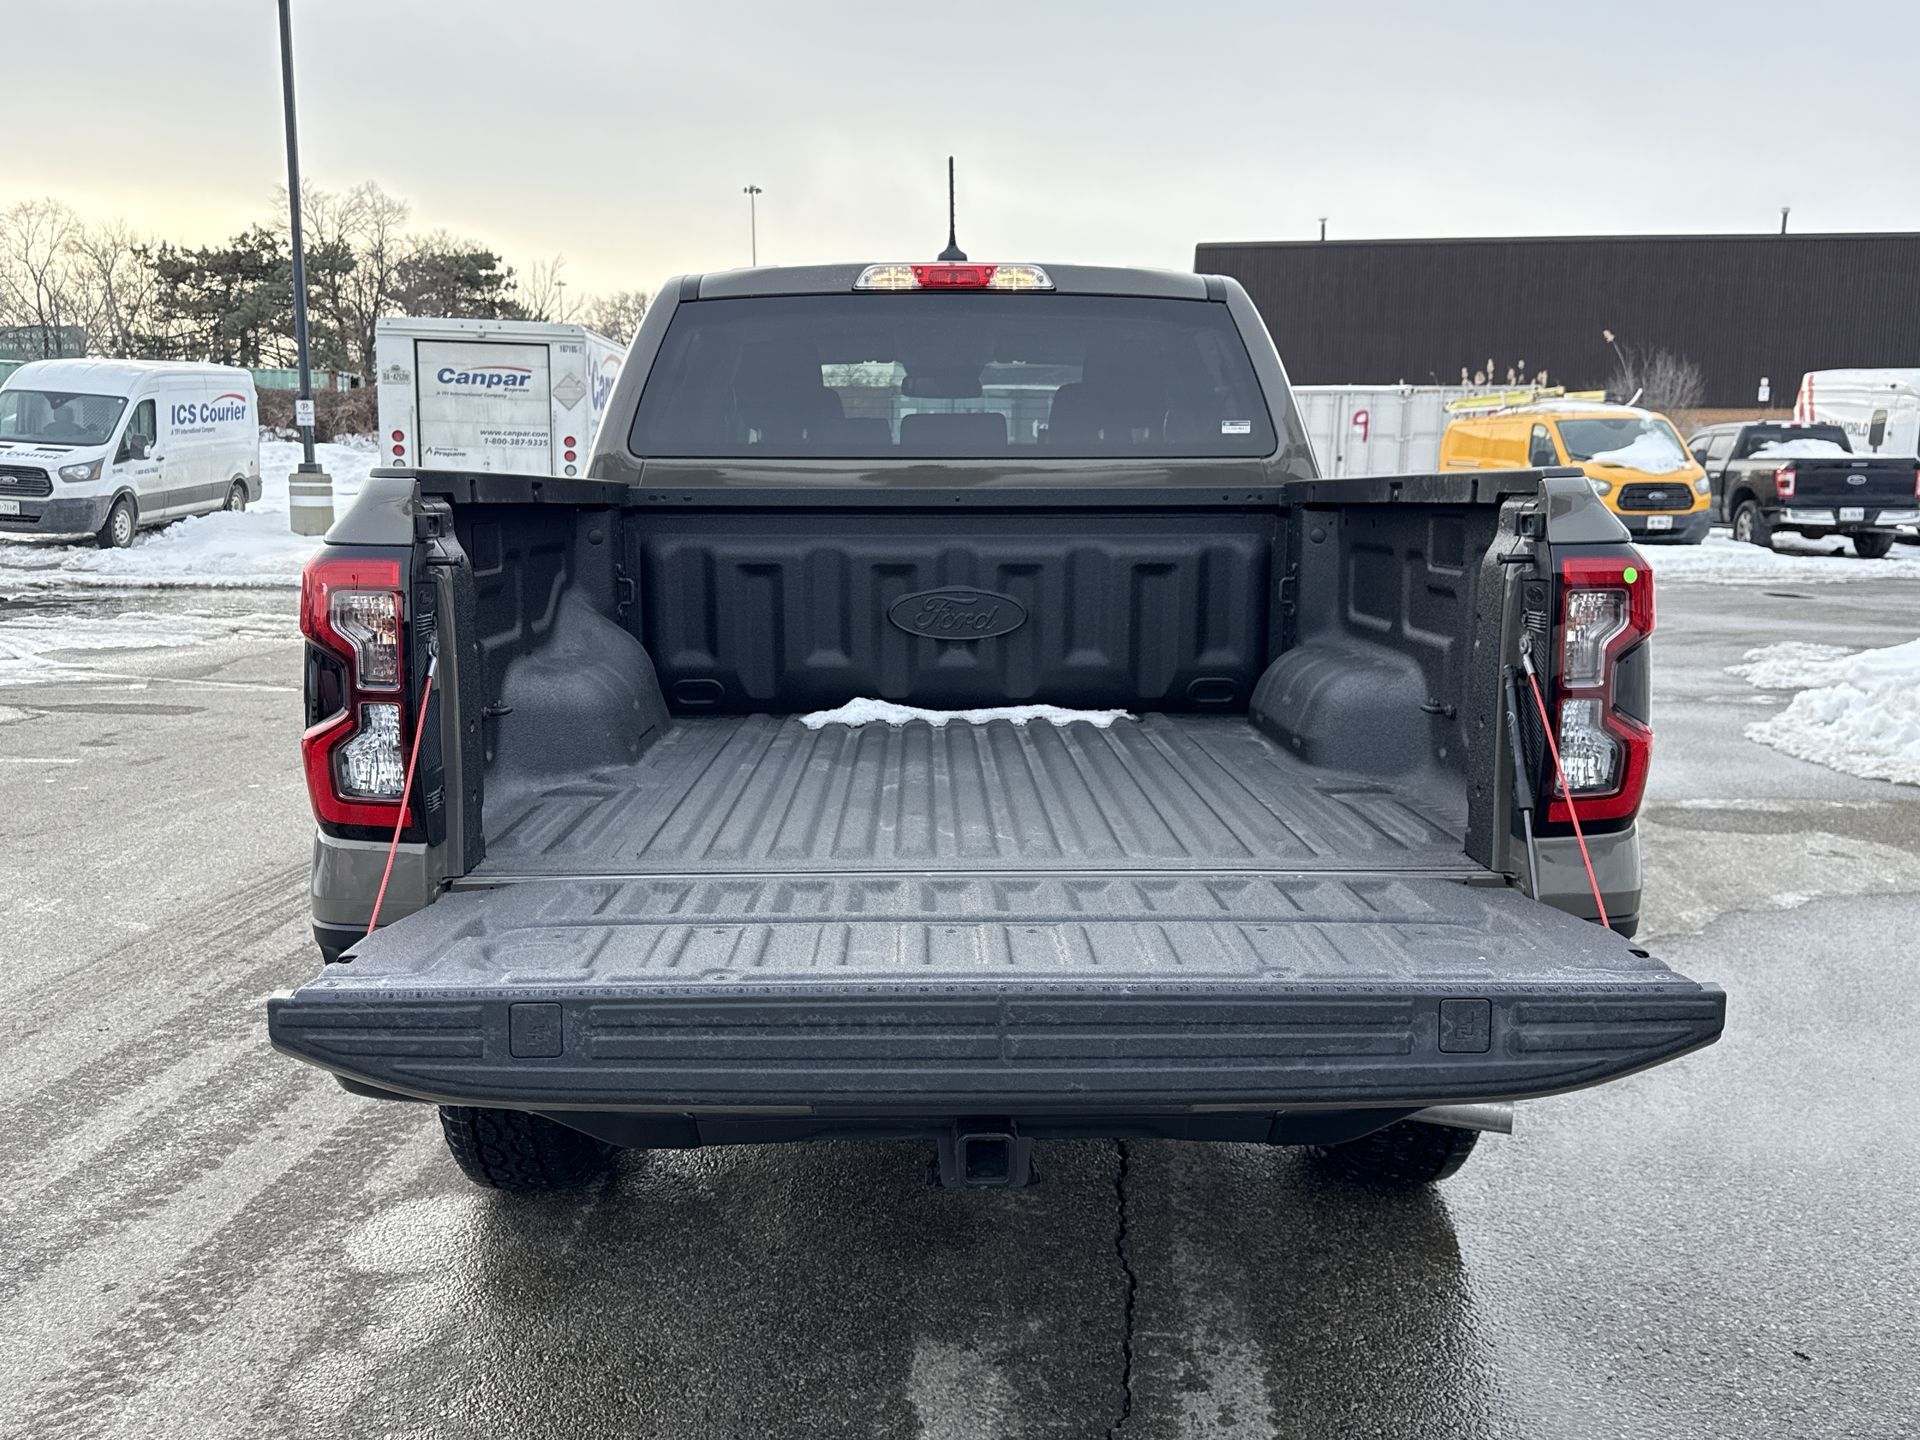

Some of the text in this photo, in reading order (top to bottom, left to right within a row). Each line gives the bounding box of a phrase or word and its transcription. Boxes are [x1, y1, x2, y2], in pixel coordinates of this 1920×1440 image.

[437, 367, 532, 388] Canpar
[171, 400, 246, 426] ICS Courier
[181, 427, 201, 435] International
[201, 426, 216, 434] Company
[480, 429, 549, 438] www.canpar.com
[1353, 410, 1369, 443] 9
[484, 437, 549, 447] 1-800-387-9335
[914, 595, 999, 631] Ford
